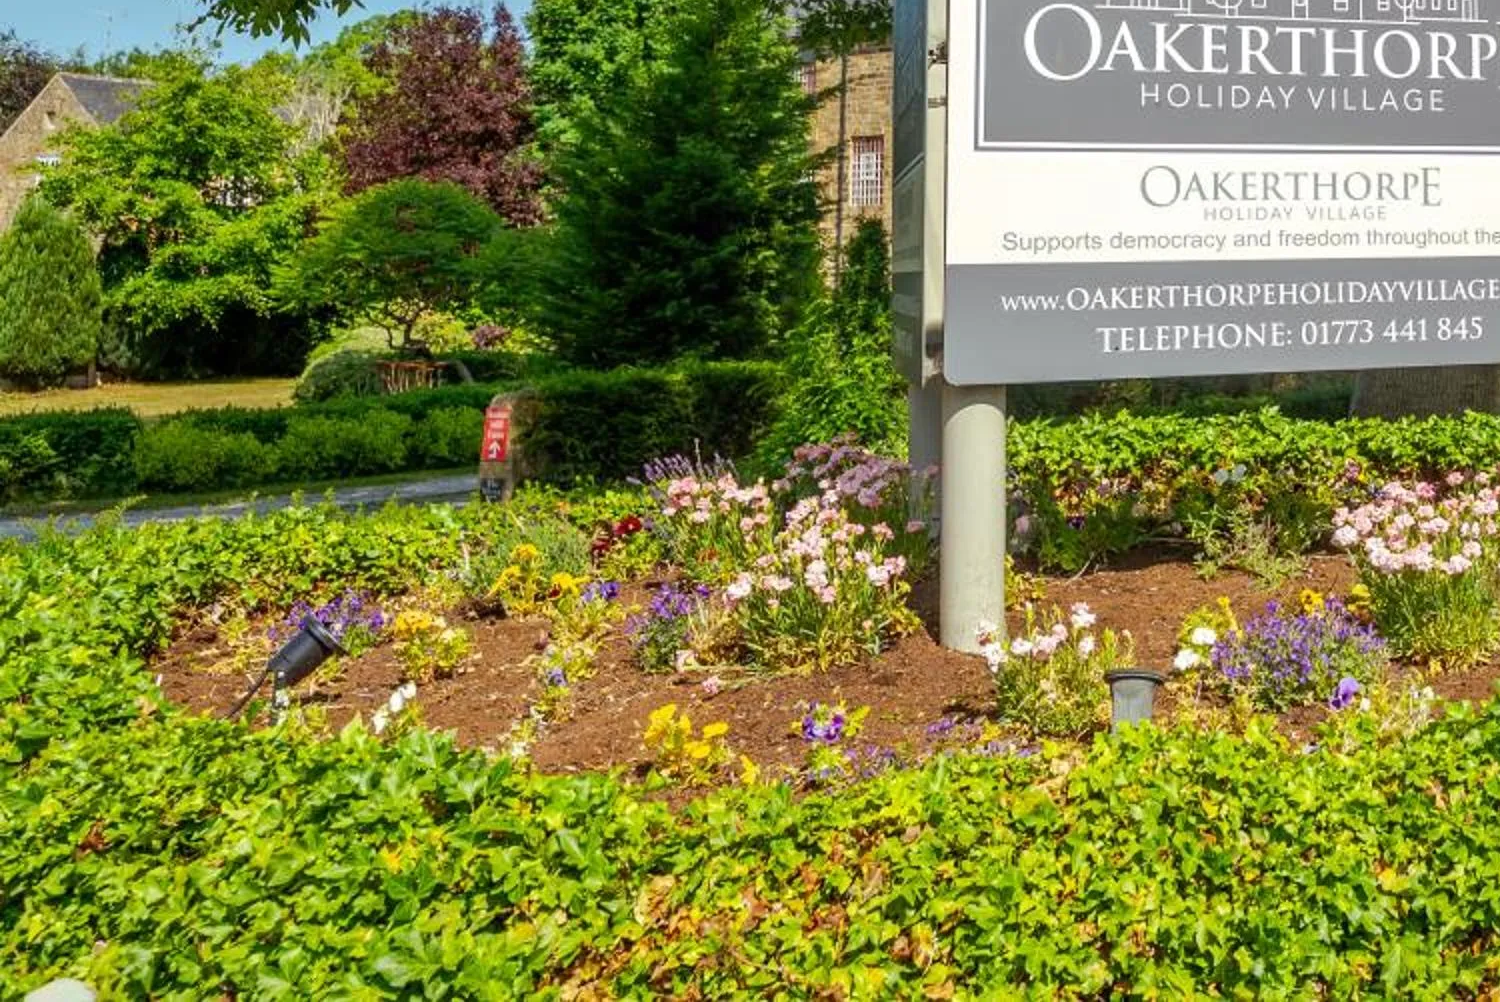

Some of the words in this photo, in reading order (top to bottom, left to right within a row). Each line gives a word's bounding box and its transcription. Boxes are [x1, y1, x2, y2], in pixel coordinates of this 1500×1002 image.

[1140, 83, 1296, 109] HOLIDAY
[1308, 87, 1446, 111] VILLAGE
[1140, 165, 1442, 208] OAKERTHORPE
[1203, 206, 1294, 222] HOLIDAY
[1306, 205, 1388, 221] VILLAGE
[1001, 231, 1103, 255] Supports
[1109, 231, 1227, 253] democracy
[1233, 230, 1271, 248] and
[1279, 229, 1360, 247] freedom
[1367, 227, 1469, 248] throughout
[1096, 322, 1293, 353] TELEPHONE:
[1301, 320, 1374, 346] 01773
[1383, 319, 1428, 343] 441
[1437, 316, 1484, 341] 845
